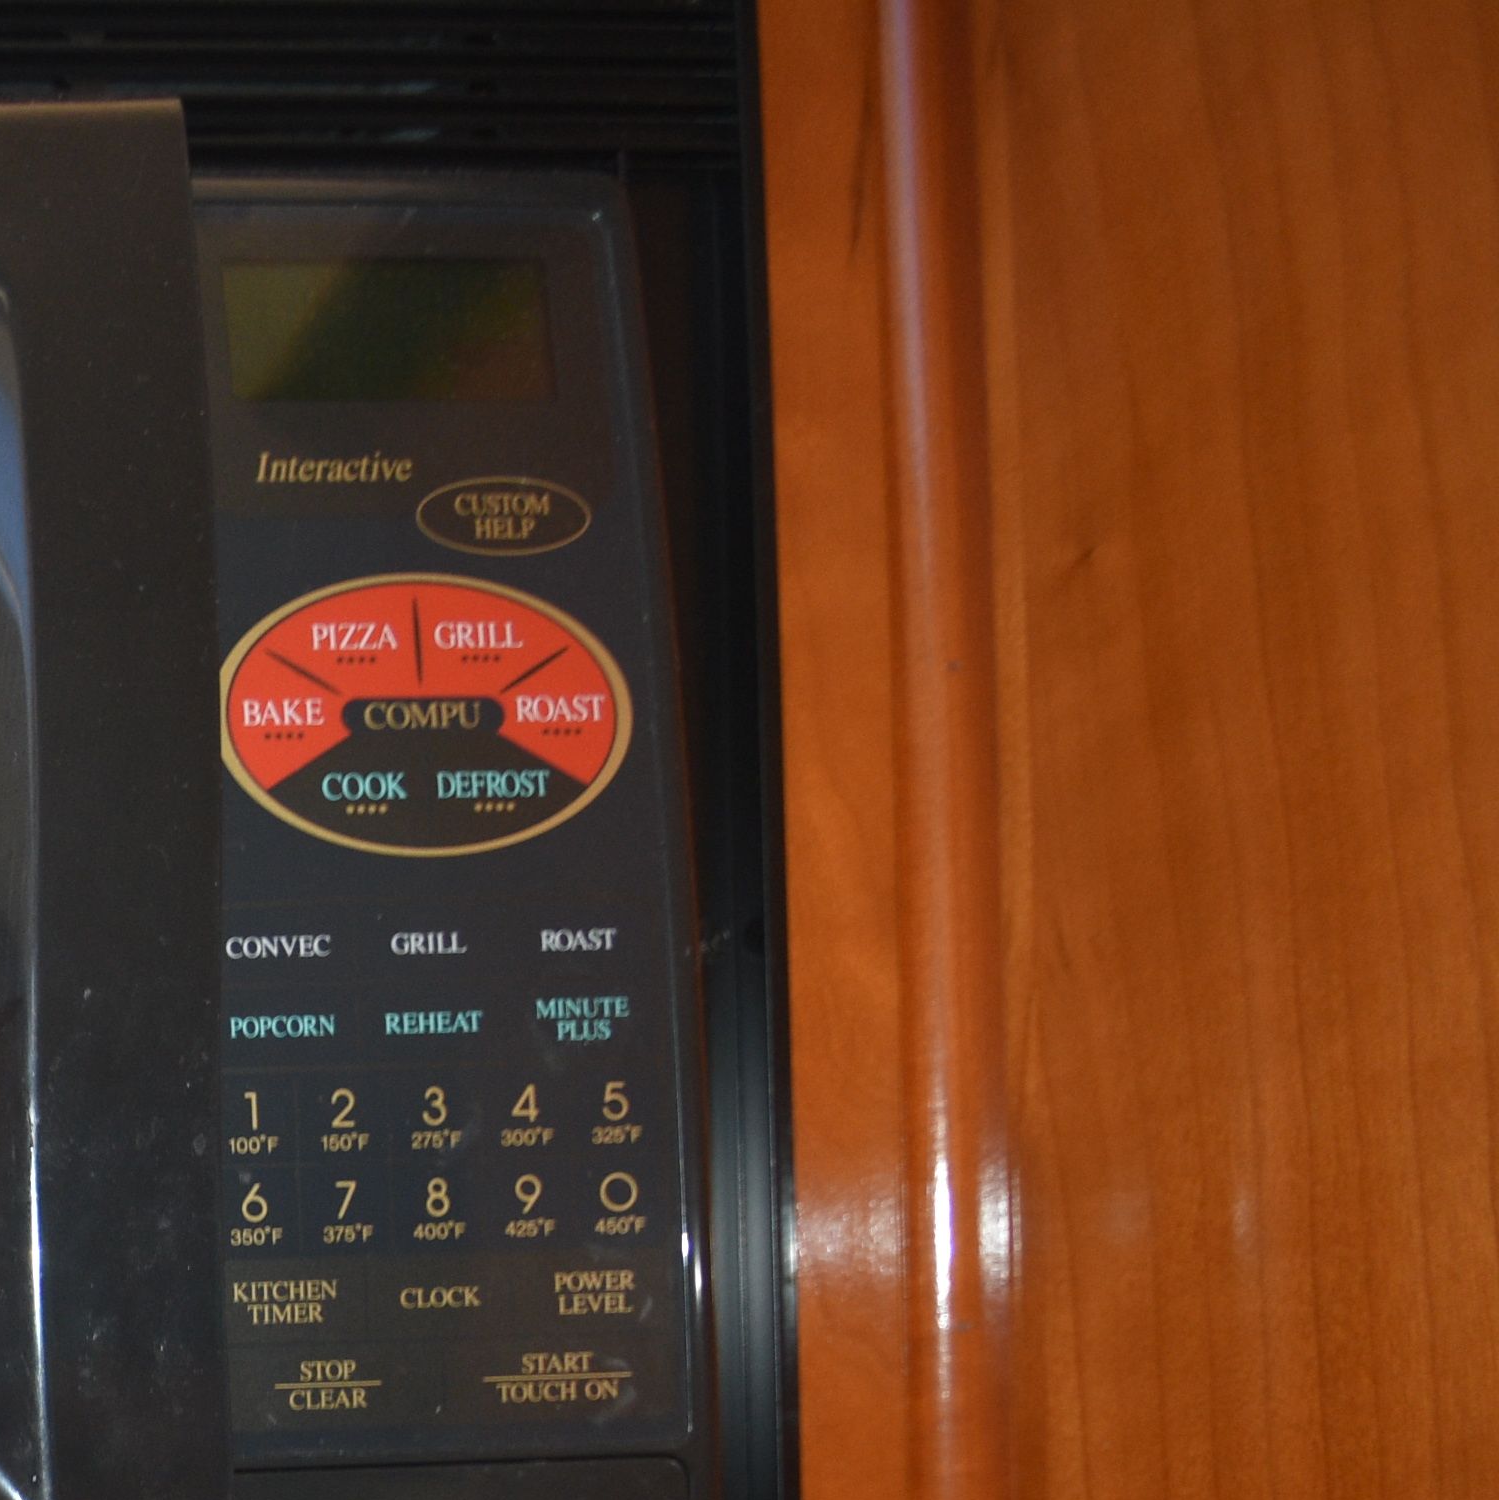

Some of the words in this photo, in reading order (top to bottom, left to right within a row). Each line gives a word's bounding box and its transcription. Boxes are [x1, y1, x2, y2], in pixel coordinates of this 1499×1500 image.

[255, 451, 413, 483] Interactive
[453, 493, 550, 517] CUSTOM
[474, 518, 535, 541] HELP
[311, 622, 398, 651] PIZZA
[434, 621, 523, 649] GRILL
[242, 698, 324, 726] BAKE
[363, 702, 481, 731] COMPU
[515, 695, 605, 723] ROAST
[321, 772, 407, 801] COOK
[436, 770, 550, 798] DEFROST
[225, 934, 331, 960] CONVEC
[390, 931, 467, 956] GRILL
[540, 928, 617, 953] ROAST
[536, 996, 630, 1021] MINUTE
[229, 1014, 336, 1039] POPCORN
[385, 1011, 484, 1035] REHEAT
[556, 1018, 612, 1043] PLUS
[243, 1090, 260, 1131] 1
[330, 1087, 357, 1129] 2
[421, 1085, 448, 1127] 3
[511, 1083, 541, 1123] 4
[602, 1081, 631, 1122] 5
[241, 1182, 268, 1224] 6
[334, 1180, 358, 1220] 7
[426, 1177, 451, 1218] 8
[514, 1174, 543, 1214] 9
[232, 1279, 338, 1303] KITCHEN
[554, 1270, 636, 1295] POWER
[400, 1285, 480, 1310] CLOCK
[558, 1291, 634, 1316] LEVEL
[247, 1300, 325, 1325] TIMER
[299, 1360, 357, 1384] STOP
[521, 1352, 594, 1375] START
[289, 1387, 368, 1411] CLEAR
[496, 1380, 580, 1404] TOUCH
[585, 1379, 620, 1401] ON
